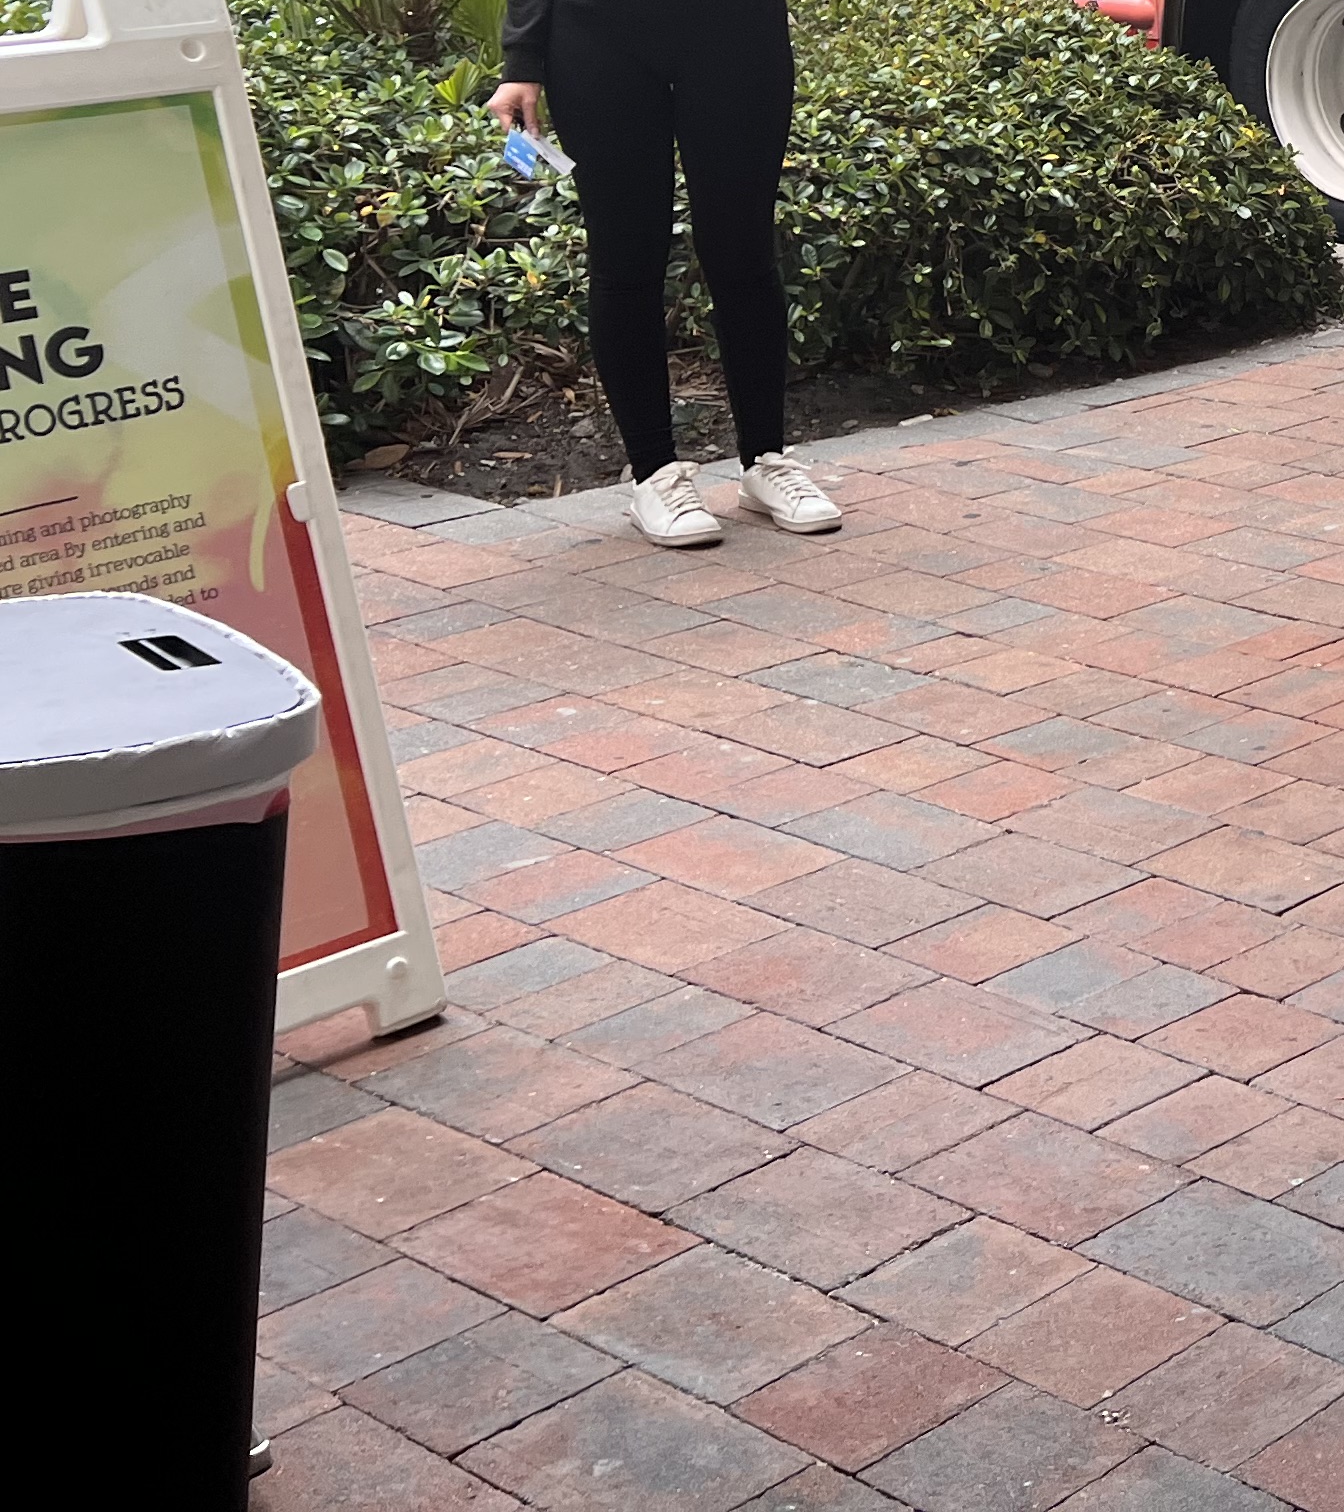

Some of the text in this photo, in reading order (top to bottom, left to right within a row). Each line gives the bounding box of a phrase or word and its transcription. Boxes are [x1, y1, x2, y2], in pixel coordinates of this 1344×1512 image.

[0, 375, 185, 445] ROGRESS
[40, 494, 192, 537] and photography
[20, 548, 60, 568] area
[64, 541, 86, 559] By
[91, 522, 170, 552] entering
[173, 512, 207, 534] and
[28, 566, 84, 595] giving
[88, 542, 191, 578] irrevocable
[162, 565, 196, 586] and
[200, 587, 219, 601] to
